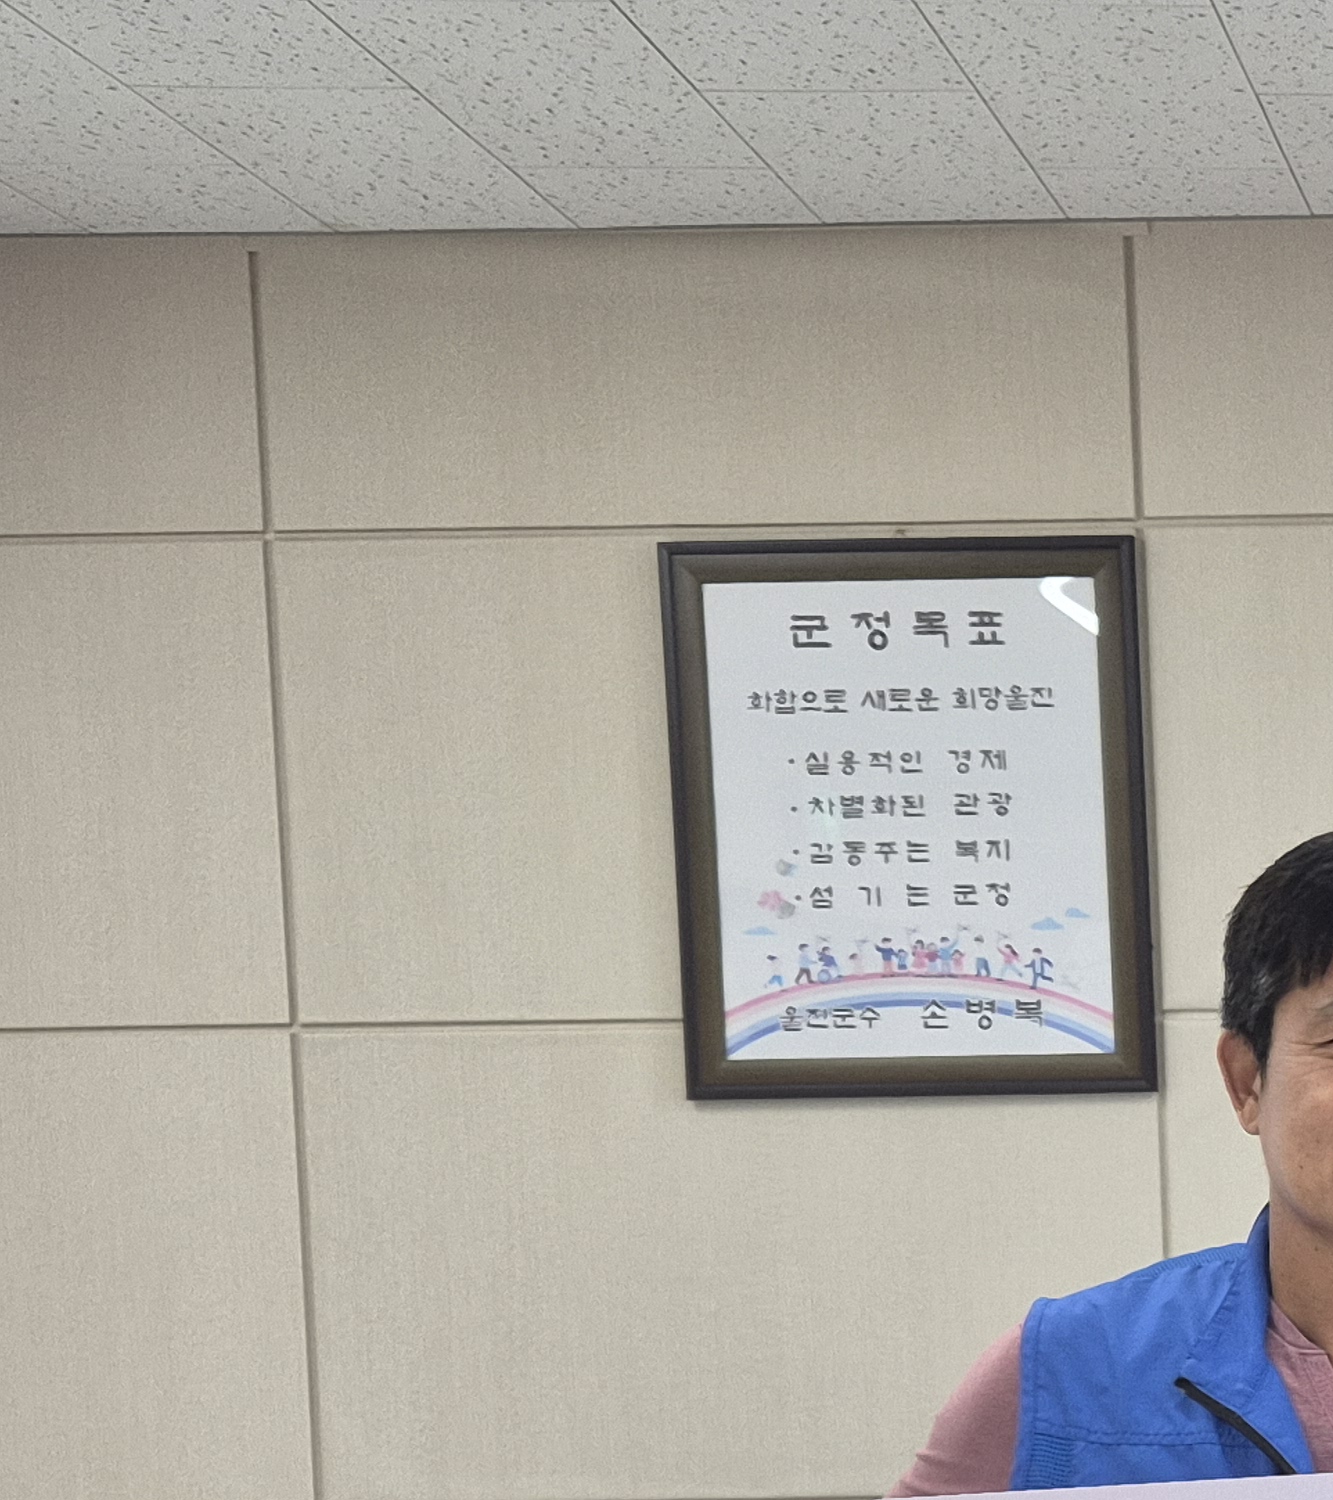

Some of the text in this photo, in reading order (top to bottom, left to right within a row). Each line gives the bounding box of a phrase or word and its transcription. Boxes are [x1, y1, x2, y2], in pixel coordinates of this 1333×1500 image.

[747, 684, 1057, 714] 화합으로 새로운 희망울진
[804, 748, 1009, 776] 실용적인 경제
[809, 792, 1013, 818] 차별화된 관광
[809, 839, 1012, 867] 감동주는 복지
[952, 882, 1012, 907] 군정
[779, 1005, 881, 1032] 울진군수
